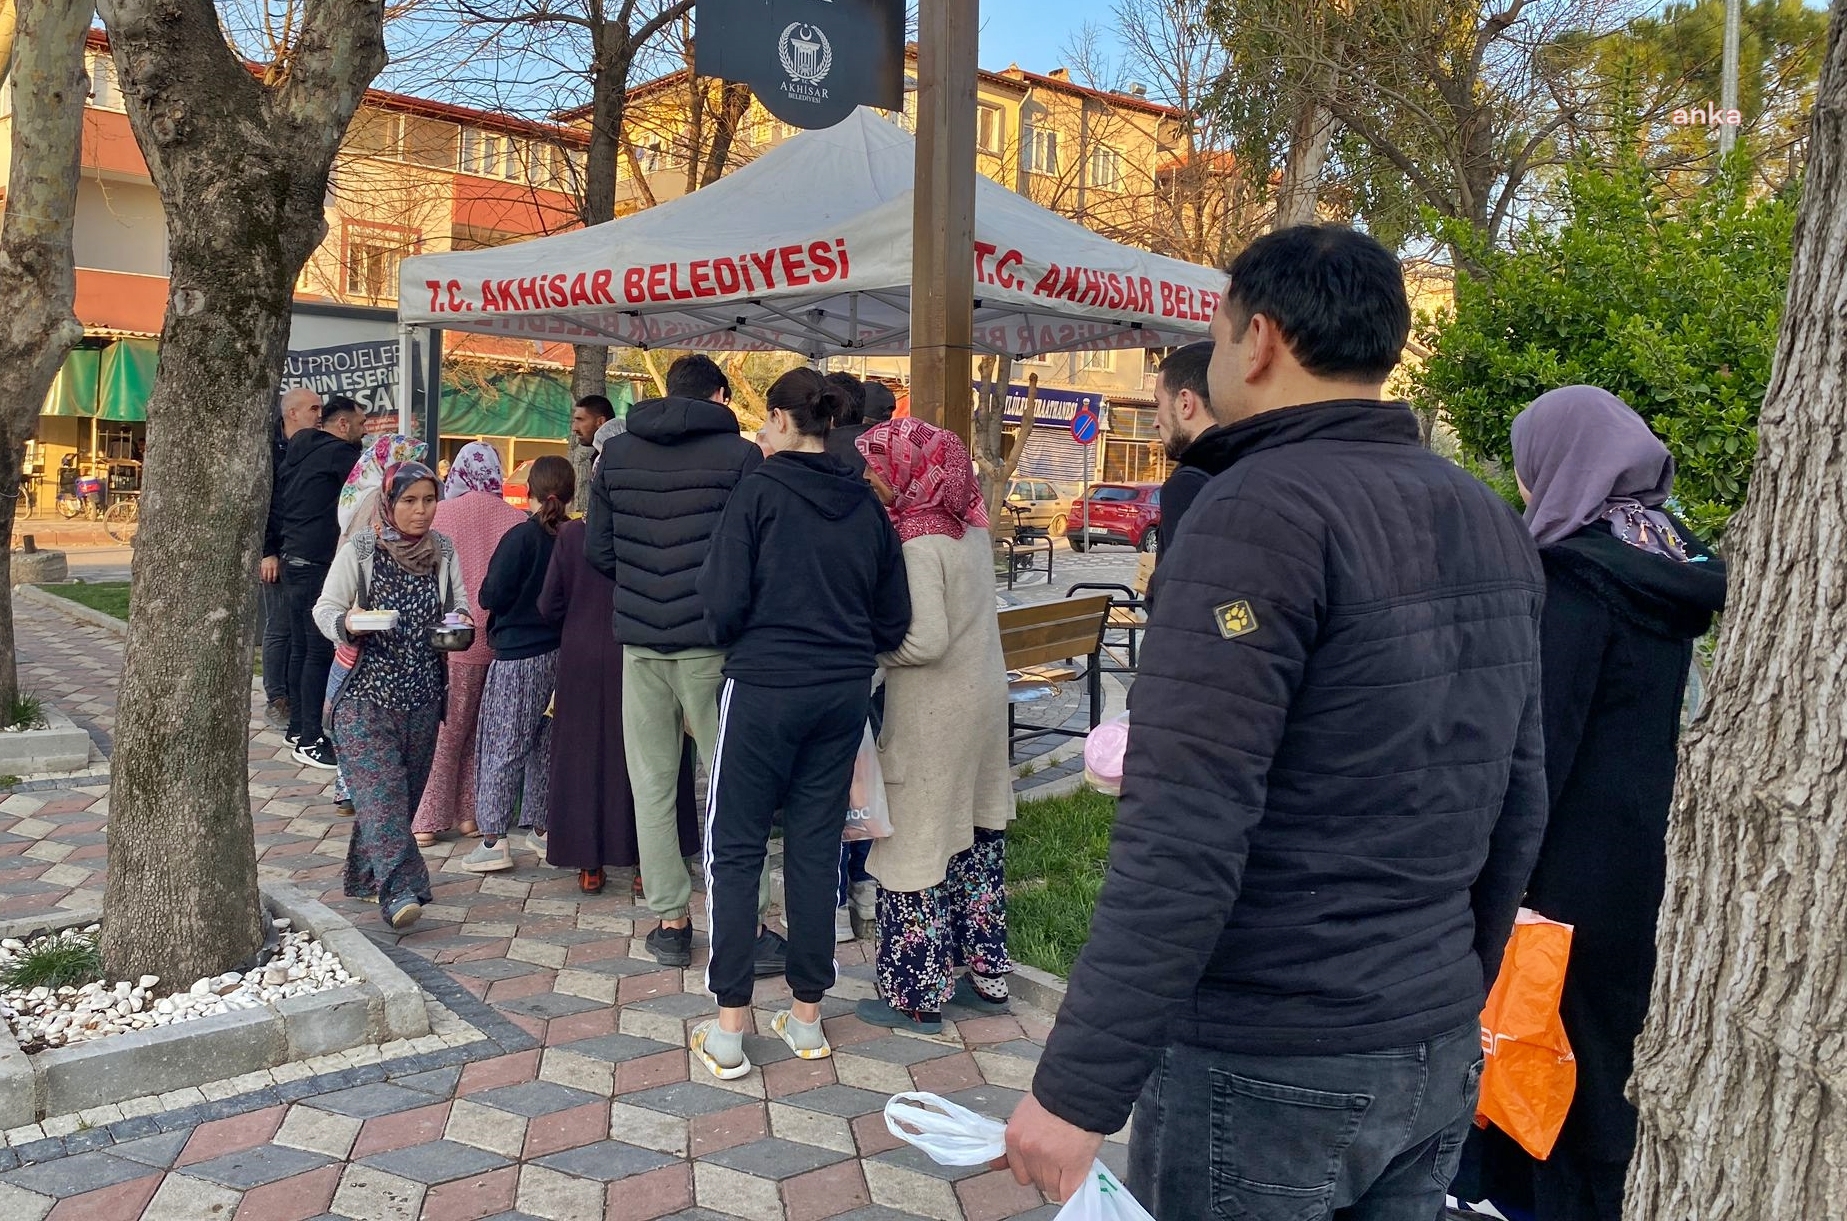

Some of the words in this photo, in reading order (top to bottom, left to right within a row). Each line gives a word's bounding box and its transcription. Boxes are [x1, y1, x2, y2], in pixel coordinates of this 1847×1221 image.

[779, 81, 829, 99] AKHİSAR
[973, 241, 1025, 292] T.C.
[425, 280, 473, 313] T.C.
